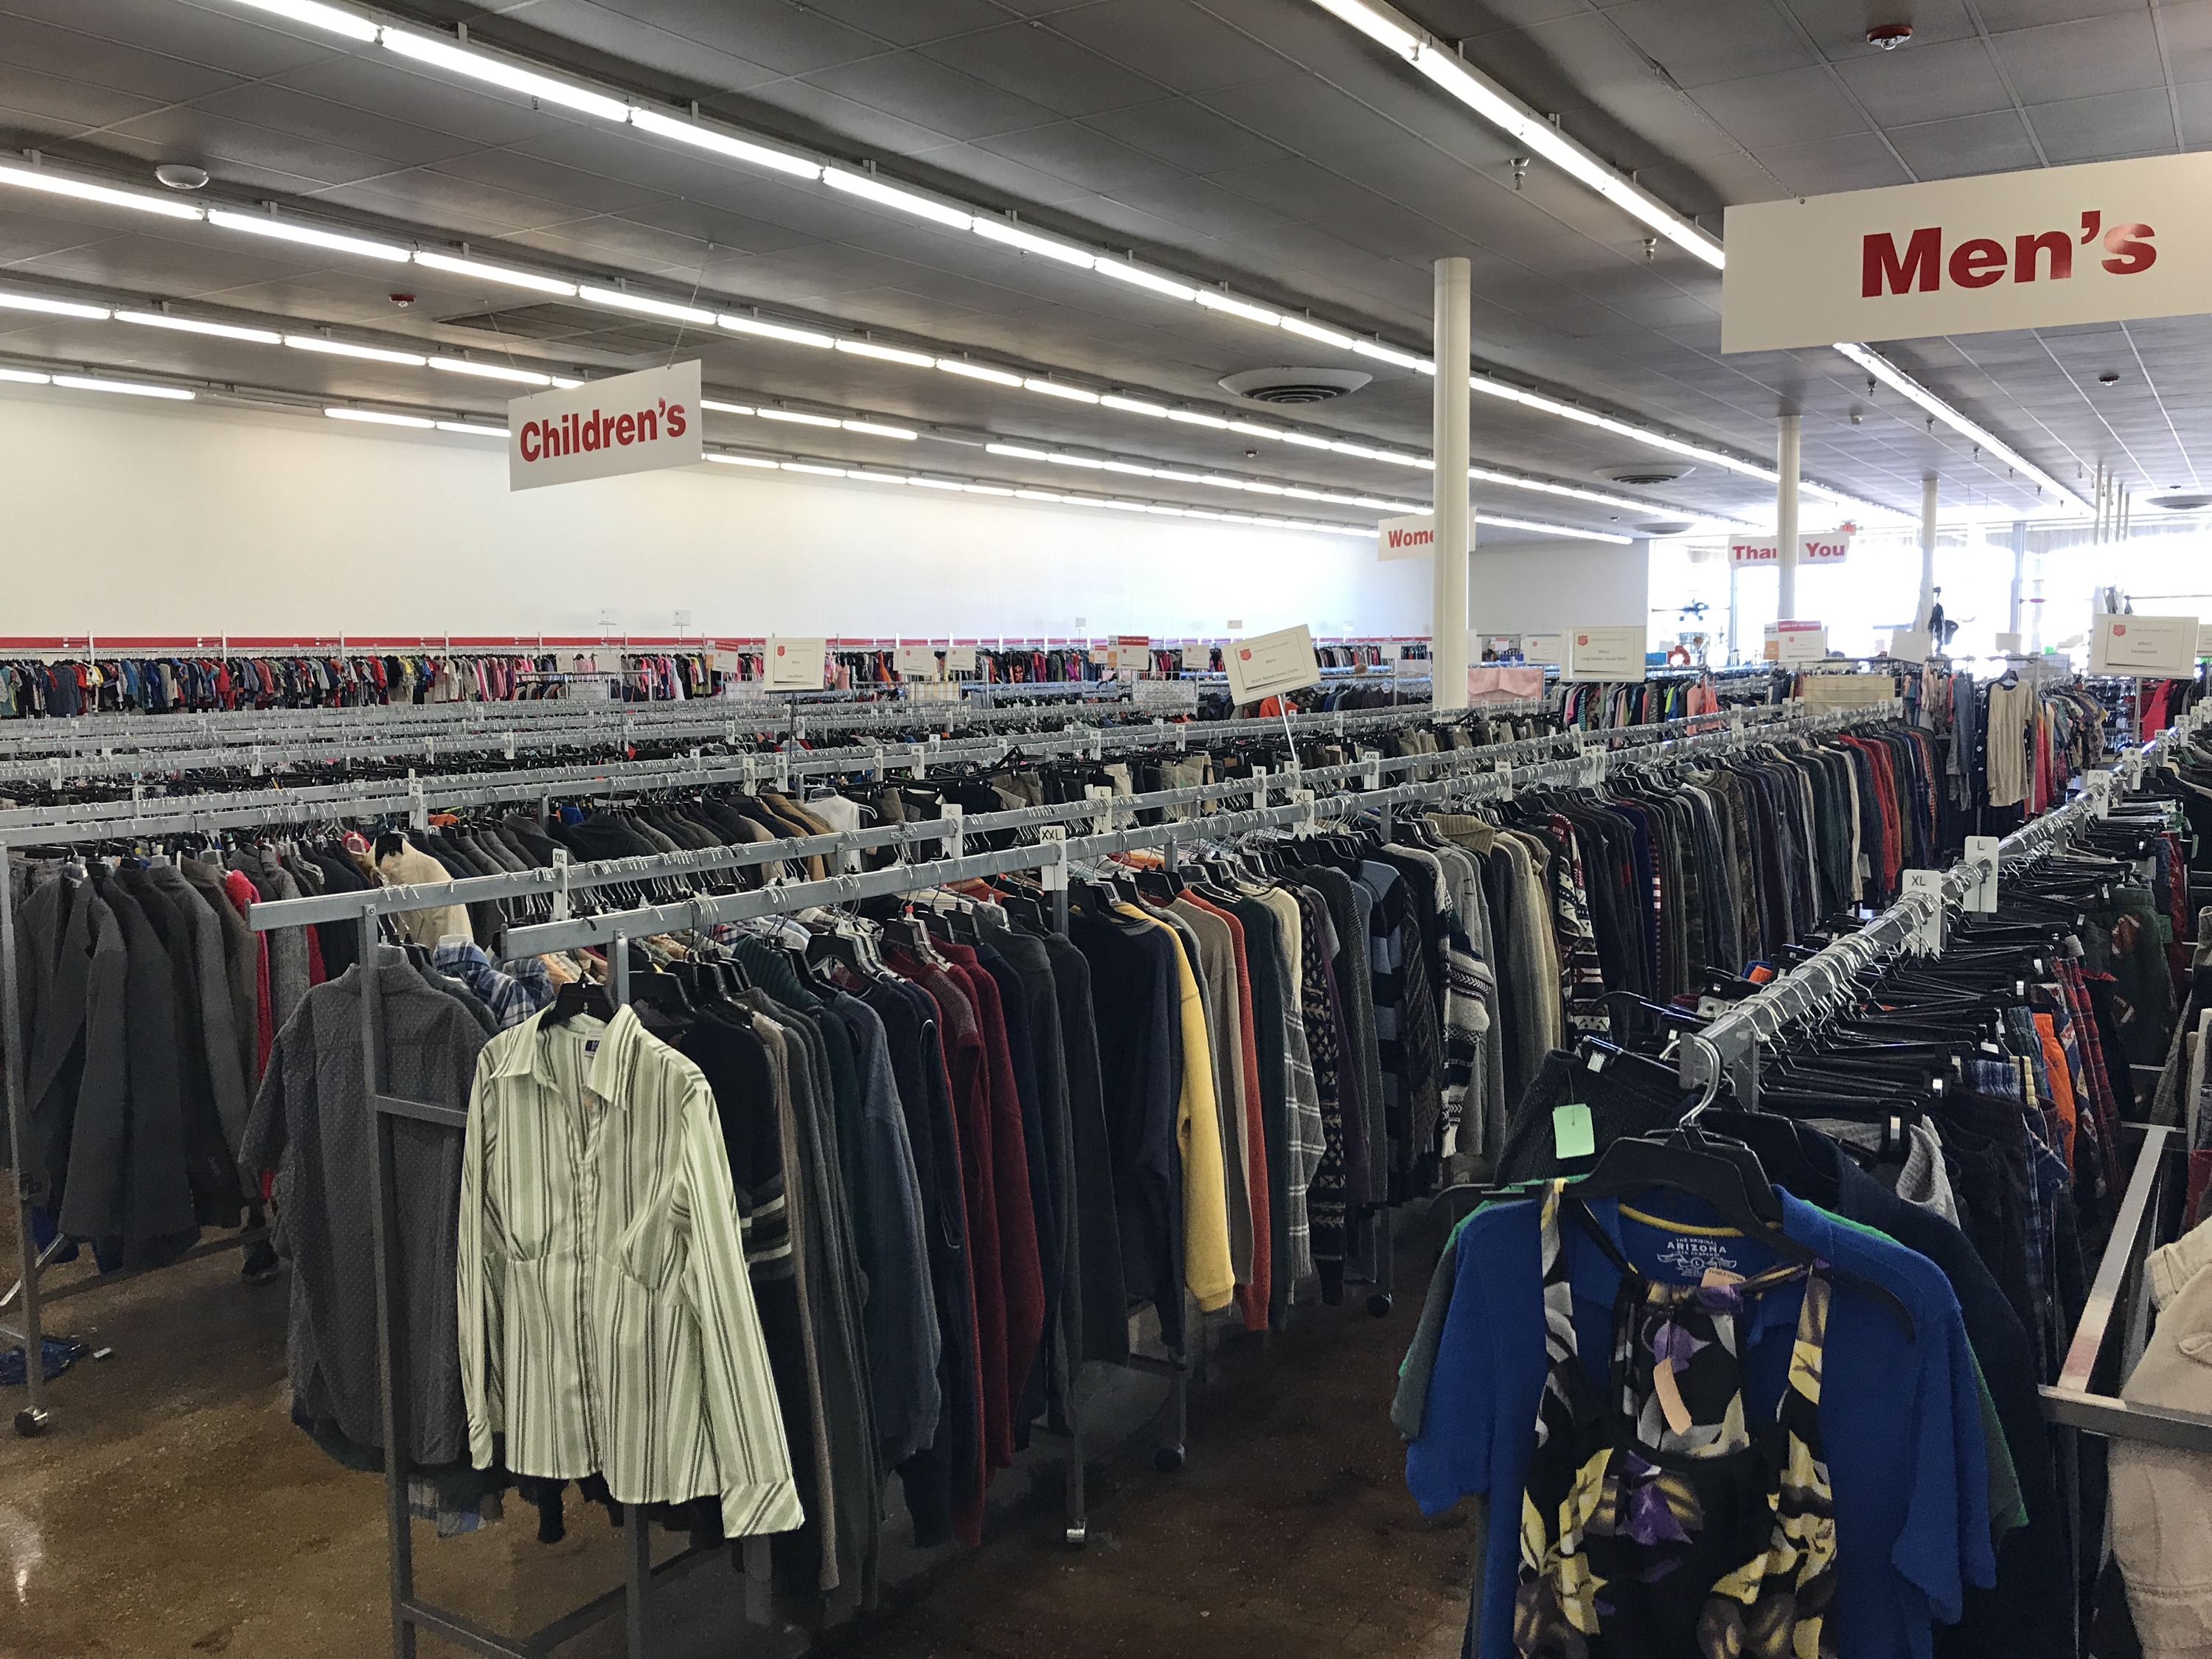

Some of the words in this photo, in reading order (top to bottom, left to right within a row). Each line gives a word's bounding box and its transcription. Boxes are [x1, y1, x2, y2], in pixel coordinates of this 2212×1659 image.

[1862, 210, 2157, 298] Men's
[520, 397, 686, 462] Children's
[1804, 542, 1845, 557] You
[2093, 772, 2104, 780] M
[1295, 793, 1310, 802] XL
[1042, 829, 1062, 841] XXL
[1978, 840, 1985, 851] L
[554, 852, 565, 864] XXL
[1911, 875, 1927, 886] XL
[1667, 1241, 1727, 1253] ARIZONA
